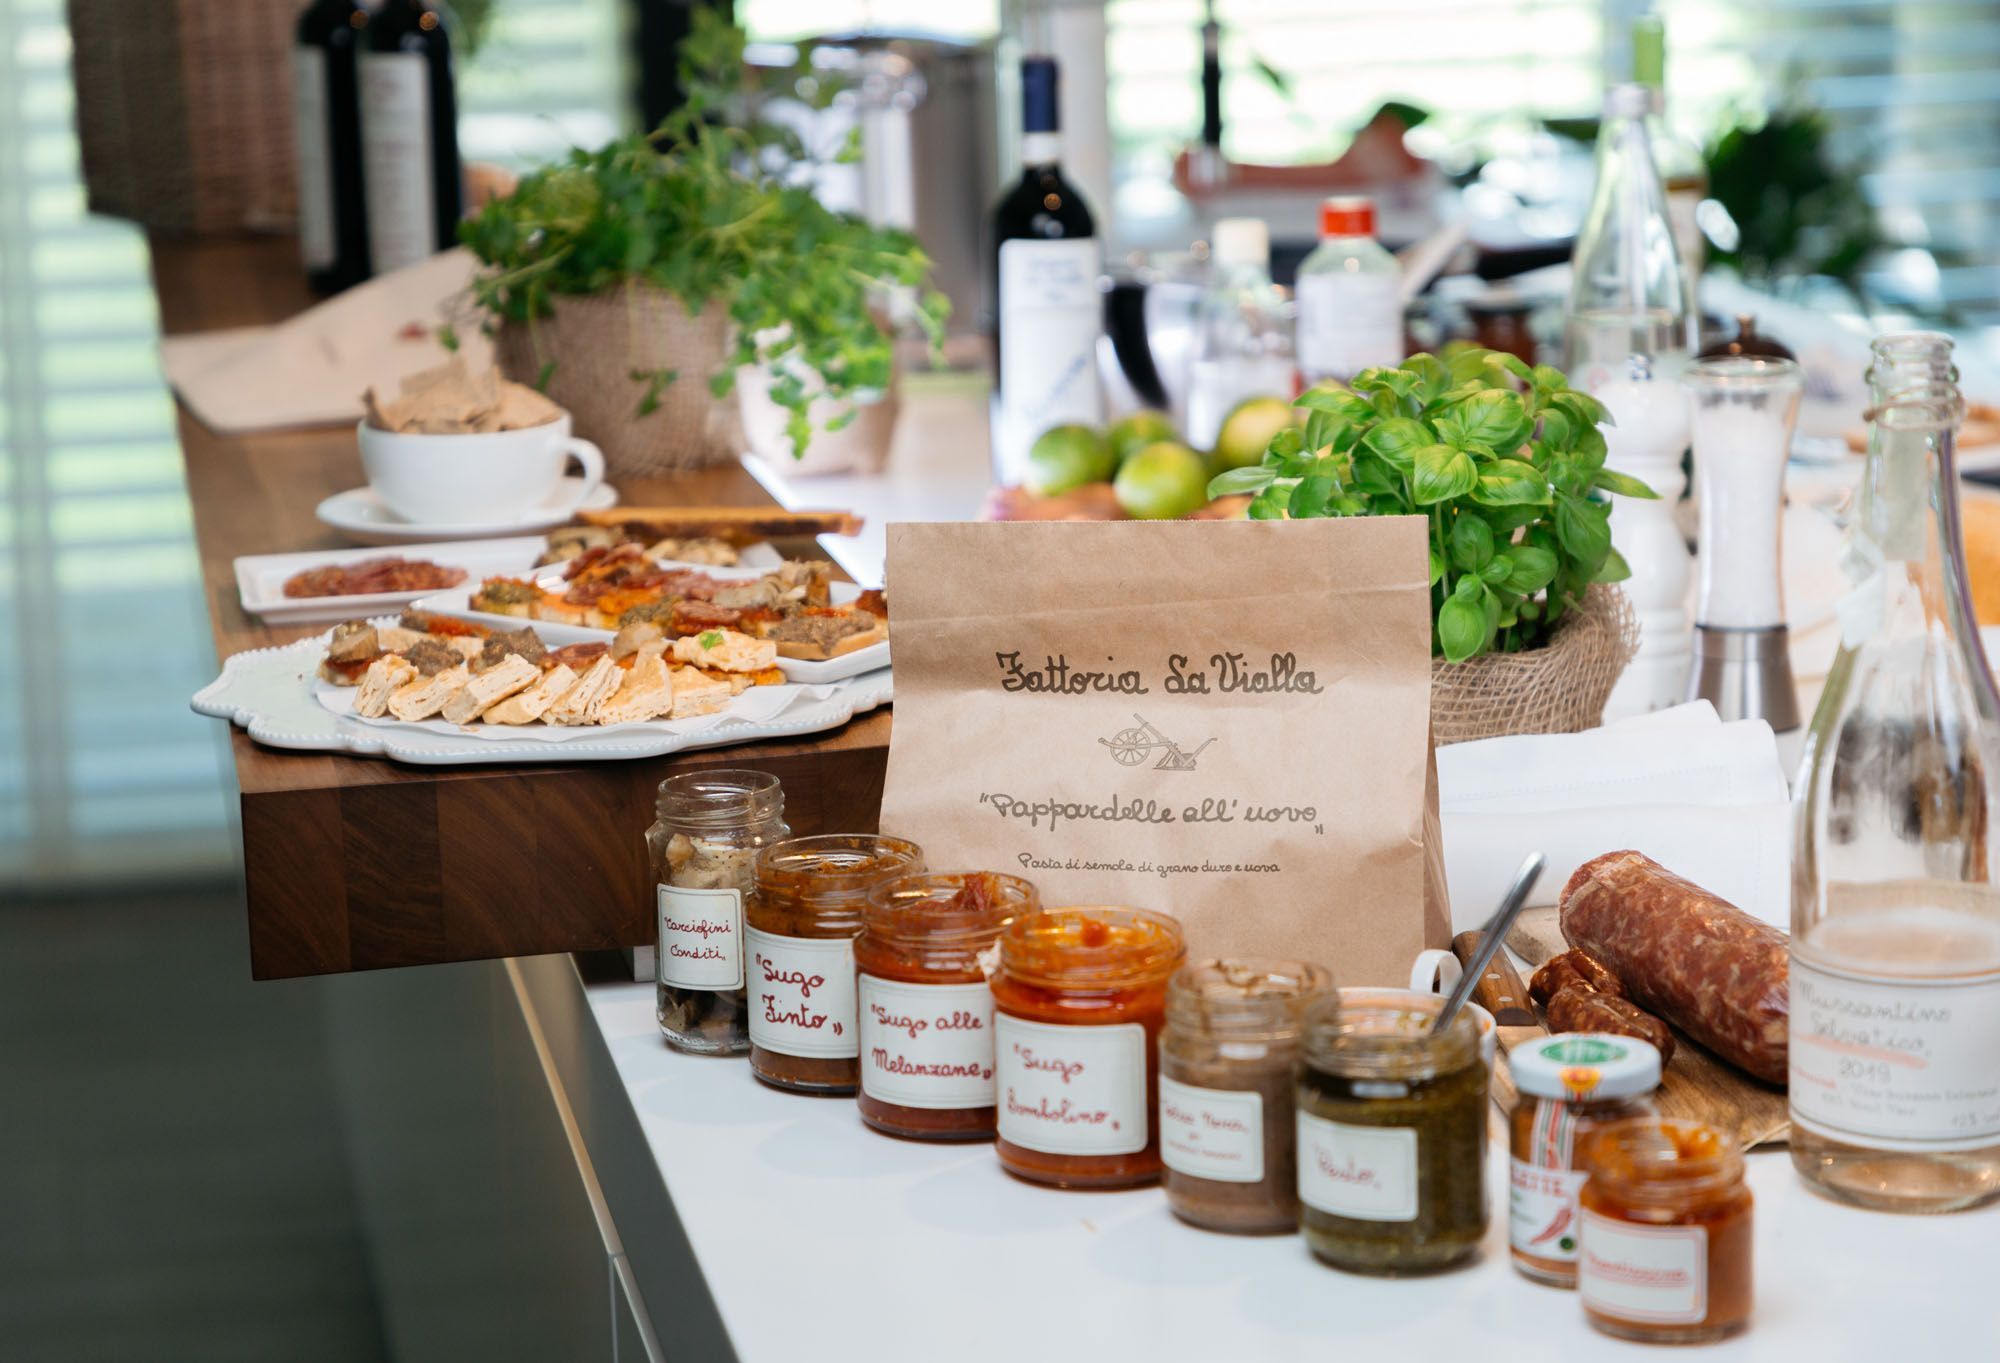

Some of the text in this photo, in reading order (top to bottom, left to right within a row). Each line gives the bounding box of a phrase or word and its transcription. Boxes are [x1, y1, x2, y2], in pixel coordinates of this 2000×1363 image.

[996, 651, 1149, 694] Fattoria
[1210, 651, 1324, 694] Vialla
[1018, 852, 1281, 878] Pasta di semola di grano duro e uova
[935, 1011, 983, 1030] alle
